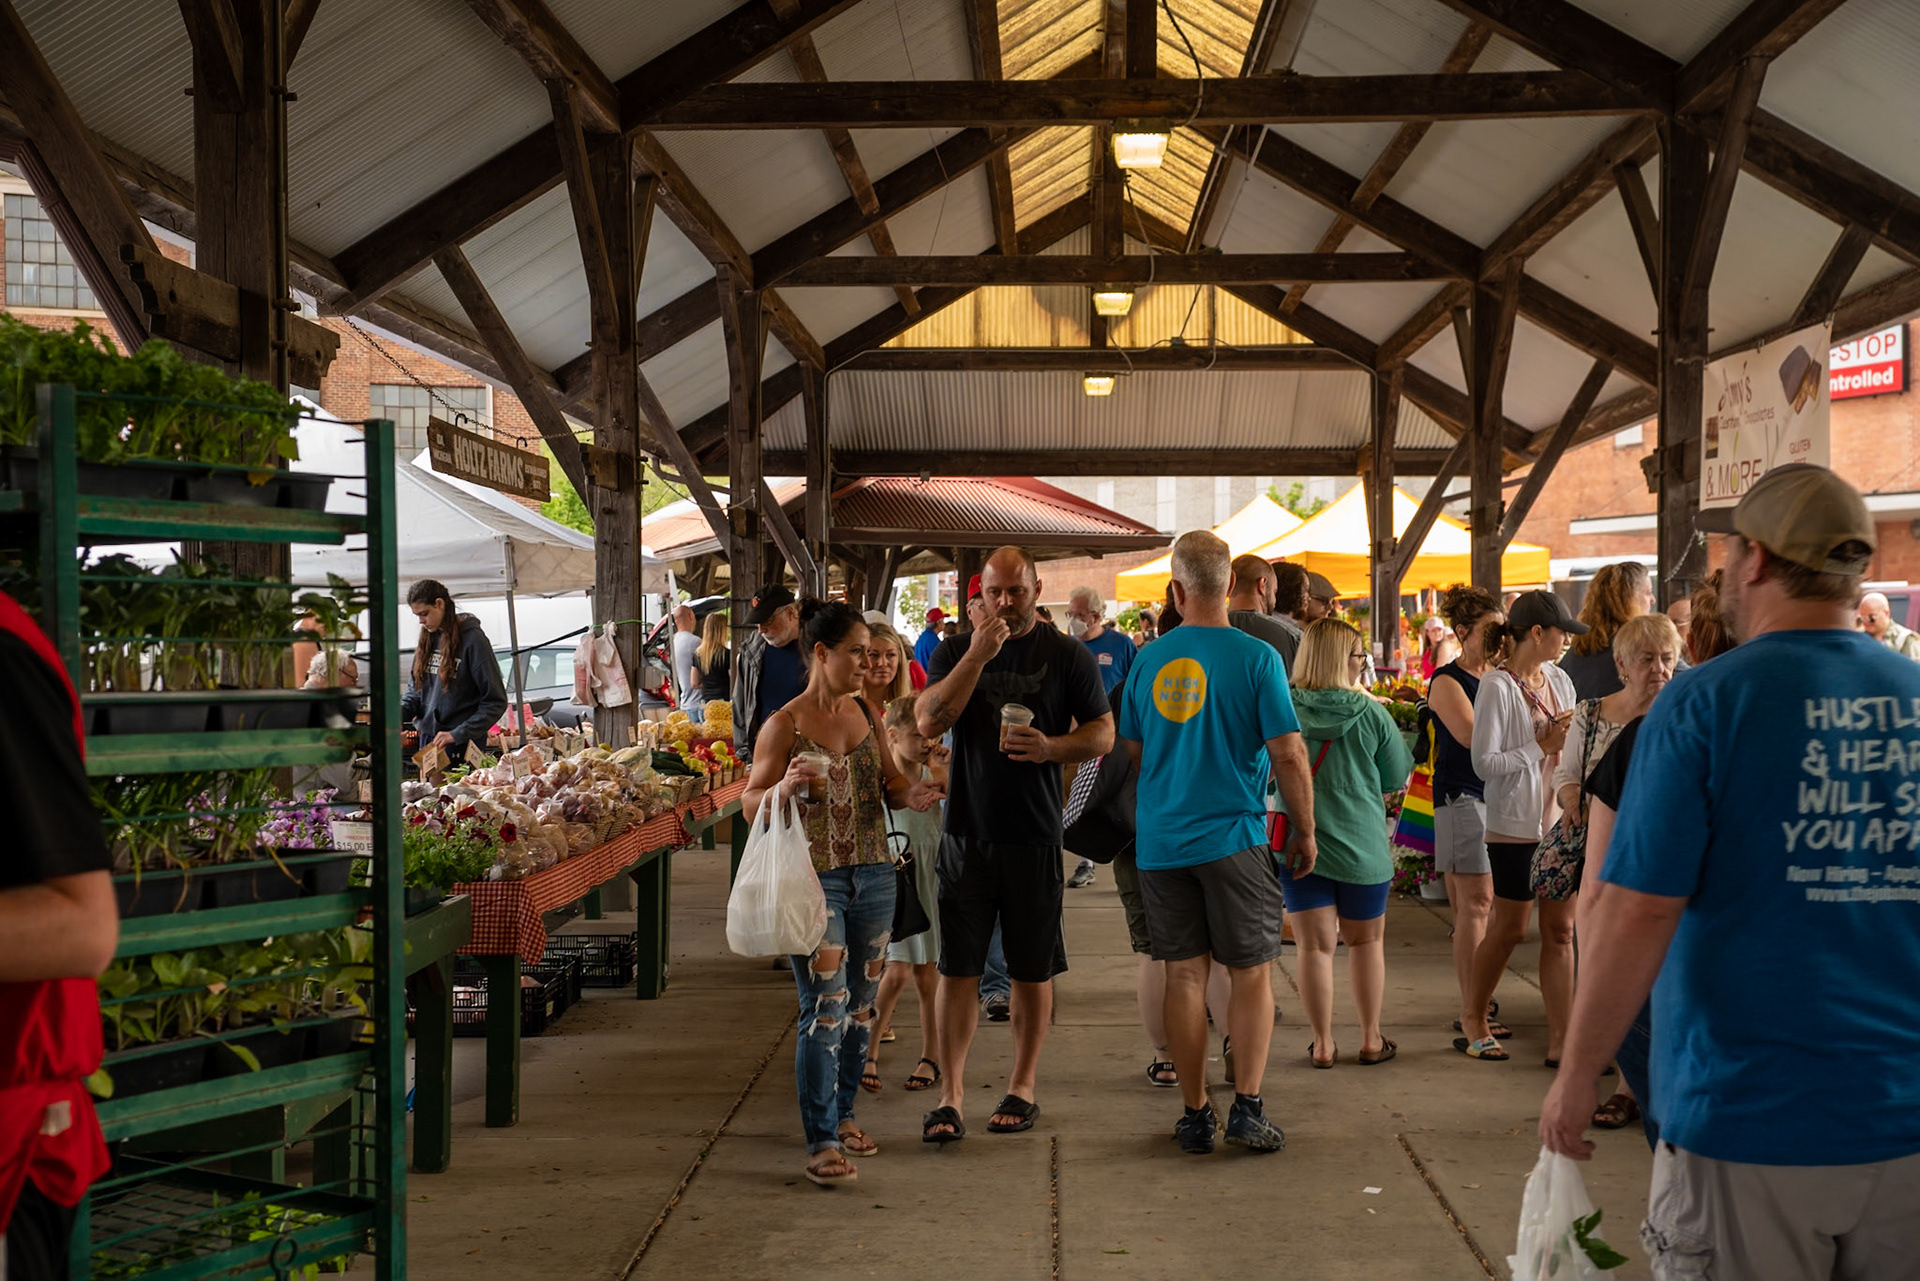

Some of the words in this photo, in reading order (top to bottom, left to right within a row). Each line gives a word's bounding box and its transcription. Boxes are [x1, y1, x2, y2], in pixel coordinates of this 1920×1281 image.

[1717, 360, 1753, 415] Amy's
[453, 433, 488, 479] HOLTZ
[486, 446, 524, 489] FARMS
[1705, 466, 1714, 497] &
[1718, 458, 1763, 496] MORE
[1159, 690, 1200, 703] NOON
[1163, 676, 1199, 690] HIGH
[1801, 738, 1830, 780] &
[1798, 780, 1887, 815] WILL
[1781, 819, 1856, 853] YOU
